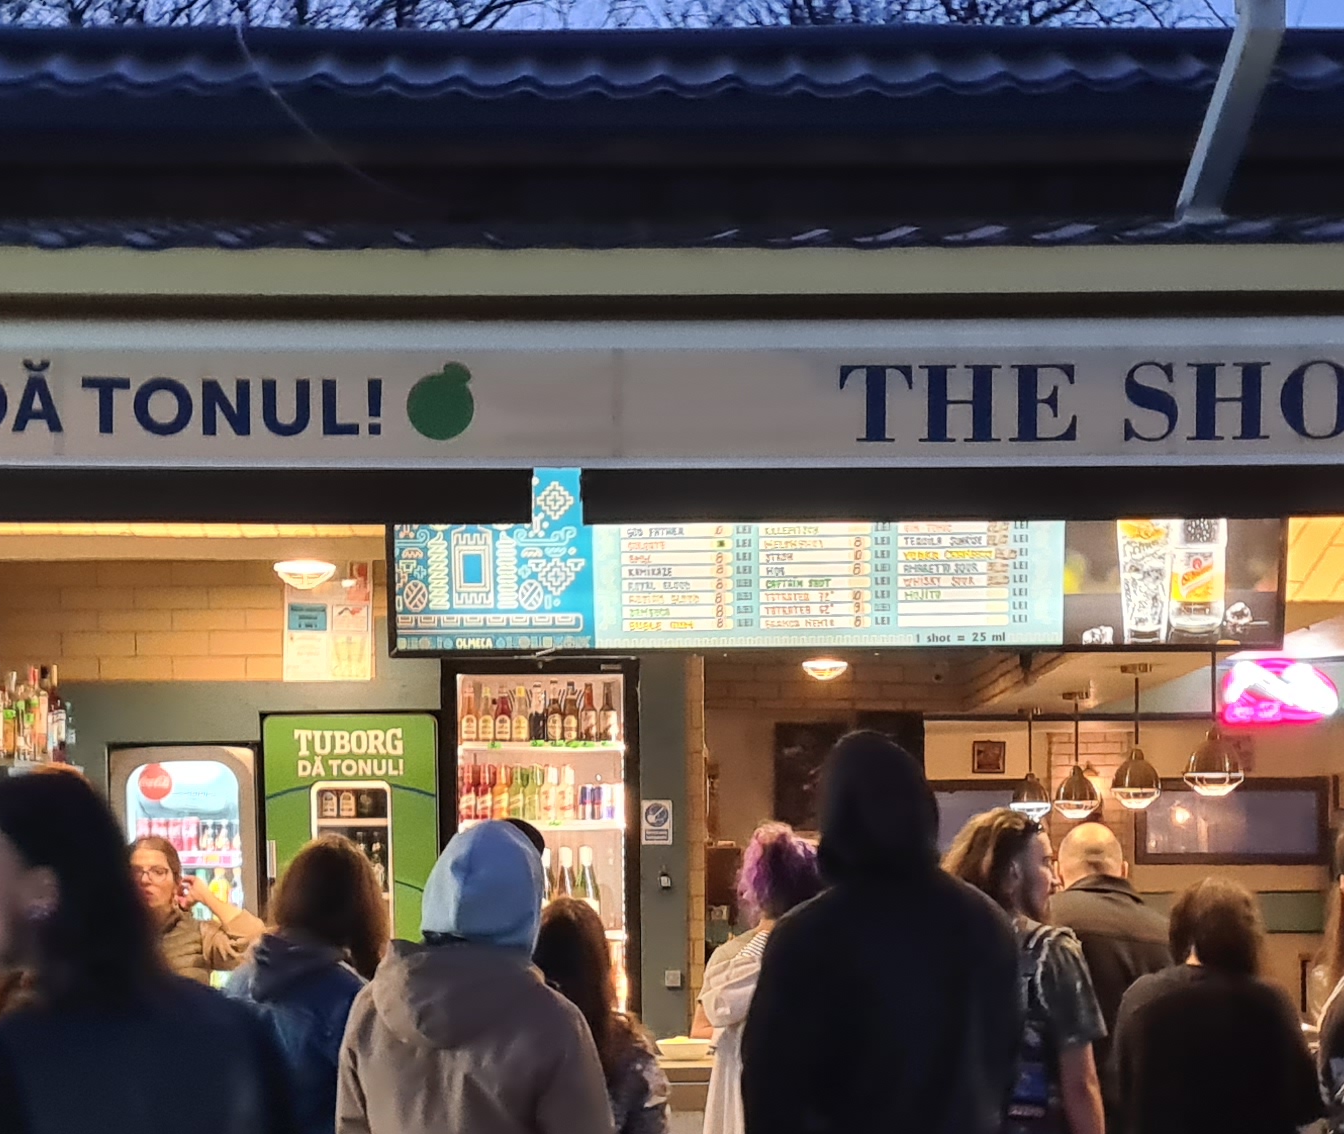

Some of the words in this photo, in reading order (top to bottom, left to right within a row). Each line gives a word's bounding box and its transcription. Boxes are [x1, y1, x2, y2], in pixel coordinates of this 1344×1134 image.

[81, 375, 383, 436] TONUL!
[839, 363, 1077, 443] THE
[874, 536, 890, 545] LEI
[1013, 534, 1028, 543] LEI
[736, 539, 751, 548] LEI
[736, 552, 751, 561] LEI
[874, 550, 890, 558] LEI
[1013, 561, 1028, 570] LEI
[628, 567, 672, 577] KAMIKAZE
[736, 566, 752, 574] LEI
[874, 577, 890, 585] LEI
[1013, 575, 1028, 583] LEI
[874, 590, 890, 598] LEI
[904, 589, 941, 600] MOJITO
[1013, 588, 1028, 596] LEI
[1013, 601, 1028, 610] LEI
[874, 617, 890, 625] LEI
[1013, 614, 1028, 623] LEI
[927, 633, 951, 642] shot
[972, 632, 986, 642] 25
[992, 631, 1006, 641] ml
[456, 637, 493, 649] OLMECA
[294, 728, 404, 756] TUBORG
[298, 756, 325, 777] DĂ
[329, 758, 404, 776] TONUL!
